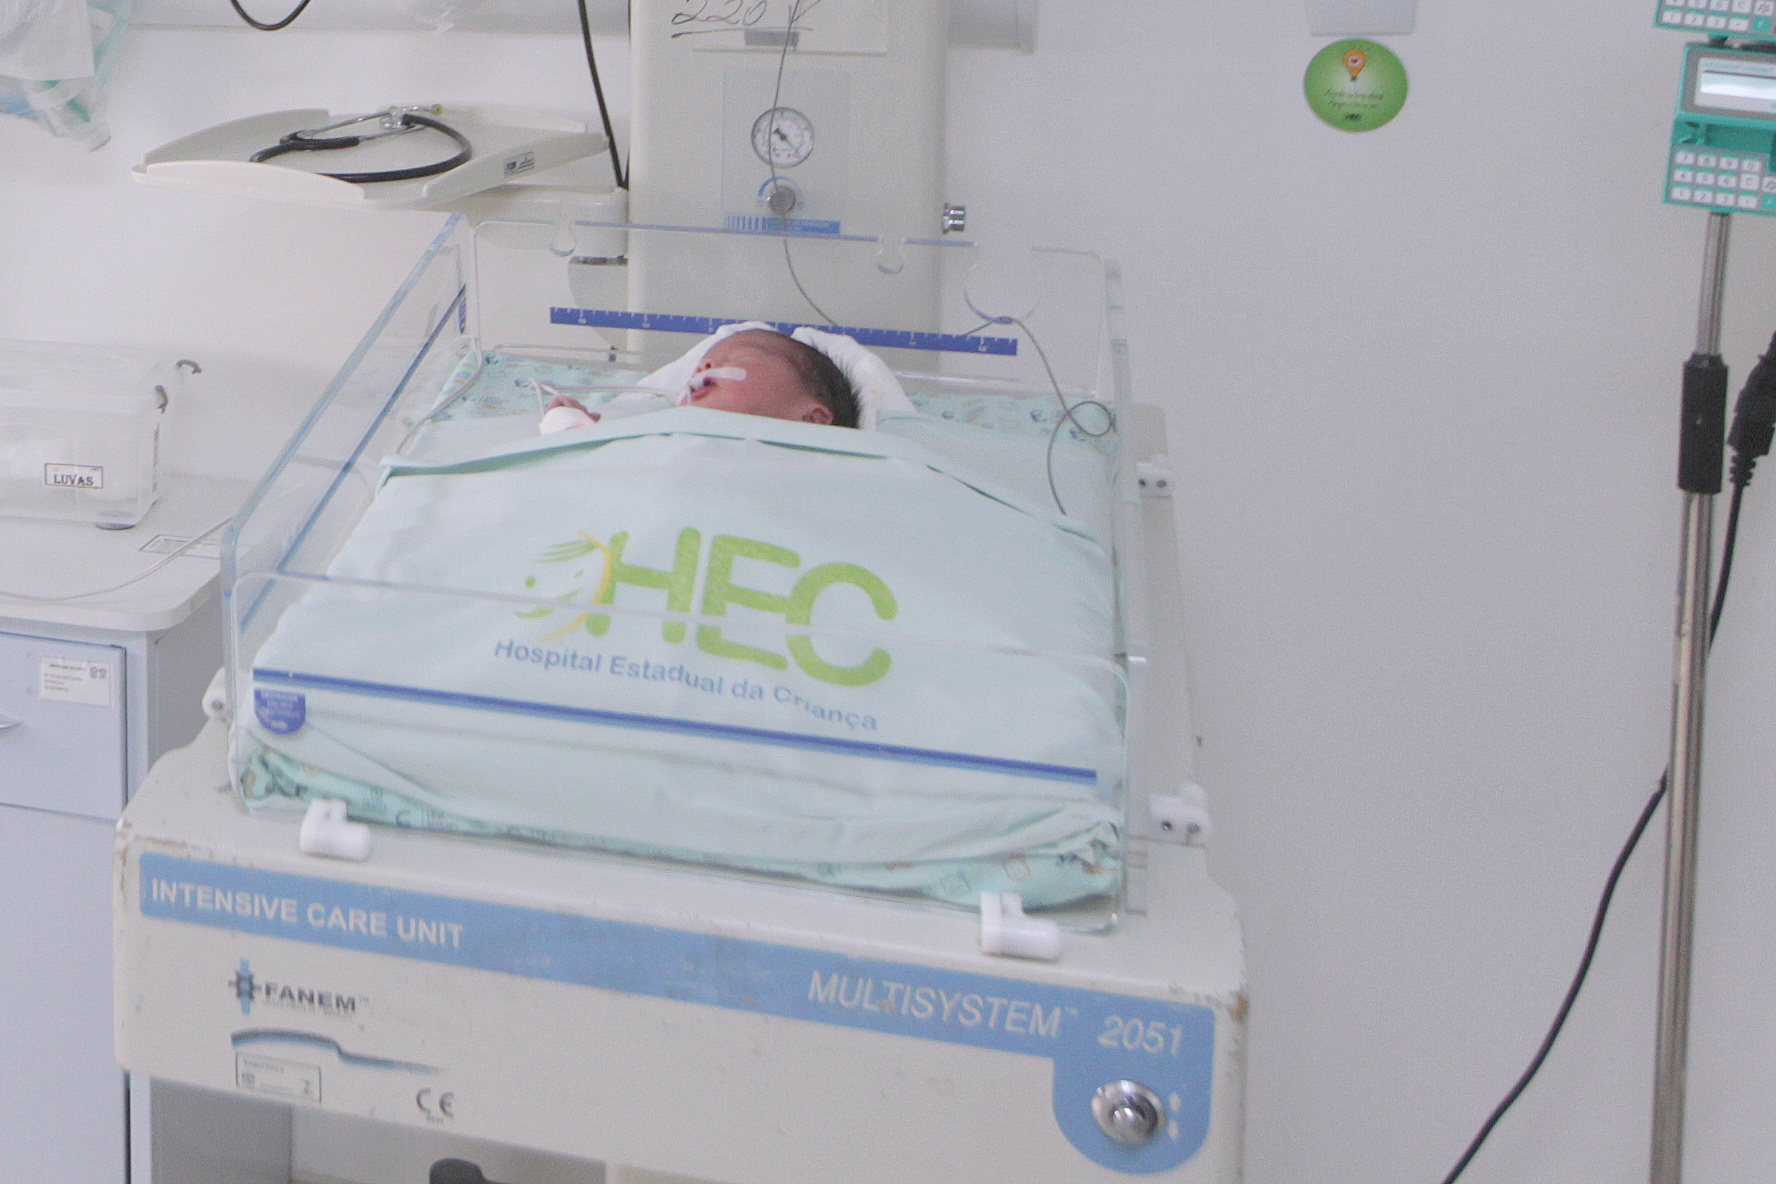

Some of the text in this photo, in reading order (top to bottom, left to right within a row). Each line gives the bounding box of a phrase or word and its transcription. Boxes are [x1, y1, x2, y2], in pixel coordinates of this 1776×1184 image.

[53, 473, 94, 486] LUVAS
[585, 526, 899, 687] HEC
[494, 637, 878, 732] Hospital Estadual da Criança
[151, 877, 464, 949] INTENSIVE CARE UNIT
[1097, 1015, 1184, 1056] 2051
